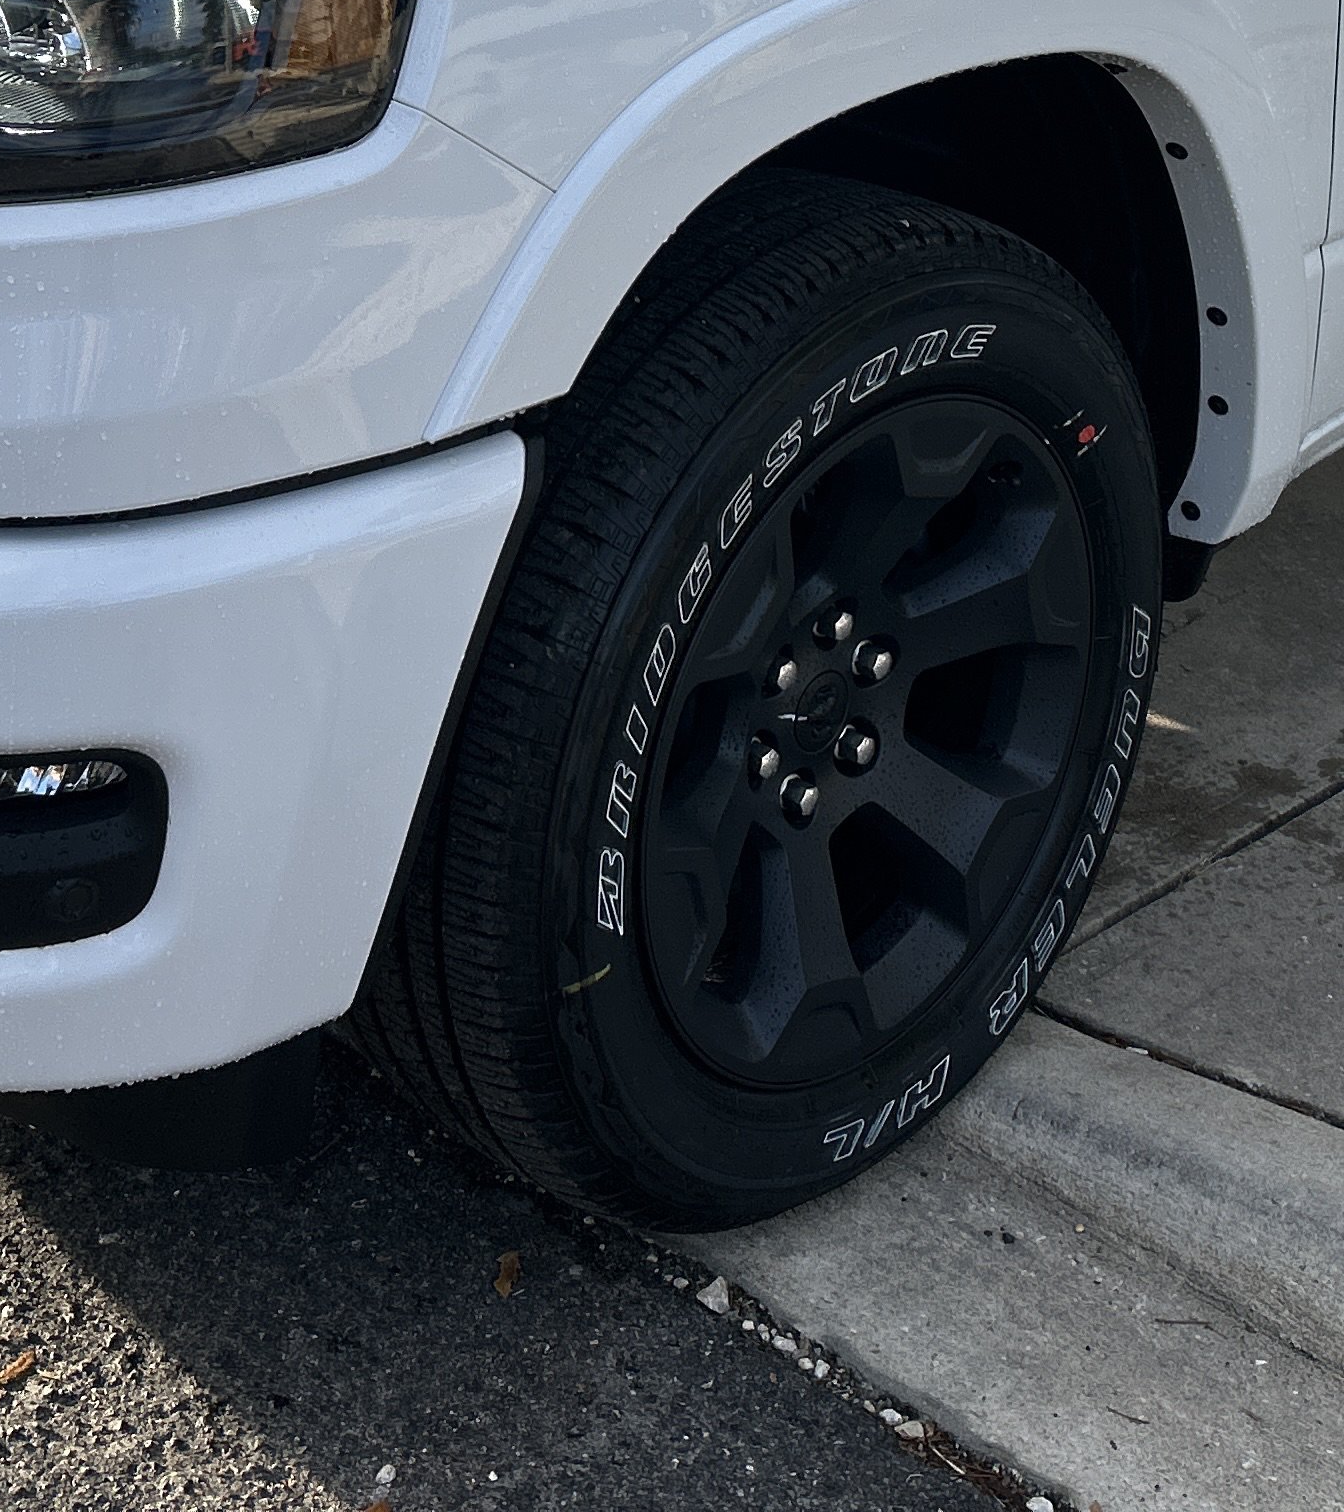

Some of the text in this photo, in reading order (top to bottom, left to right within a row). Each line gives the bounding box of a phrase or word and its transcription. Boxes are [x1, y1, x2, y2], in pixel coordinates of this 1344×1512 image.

[597, 324, 996, 936] BRIDGESTONE
[823, 604, 1150, 1162] DUELER H/L
